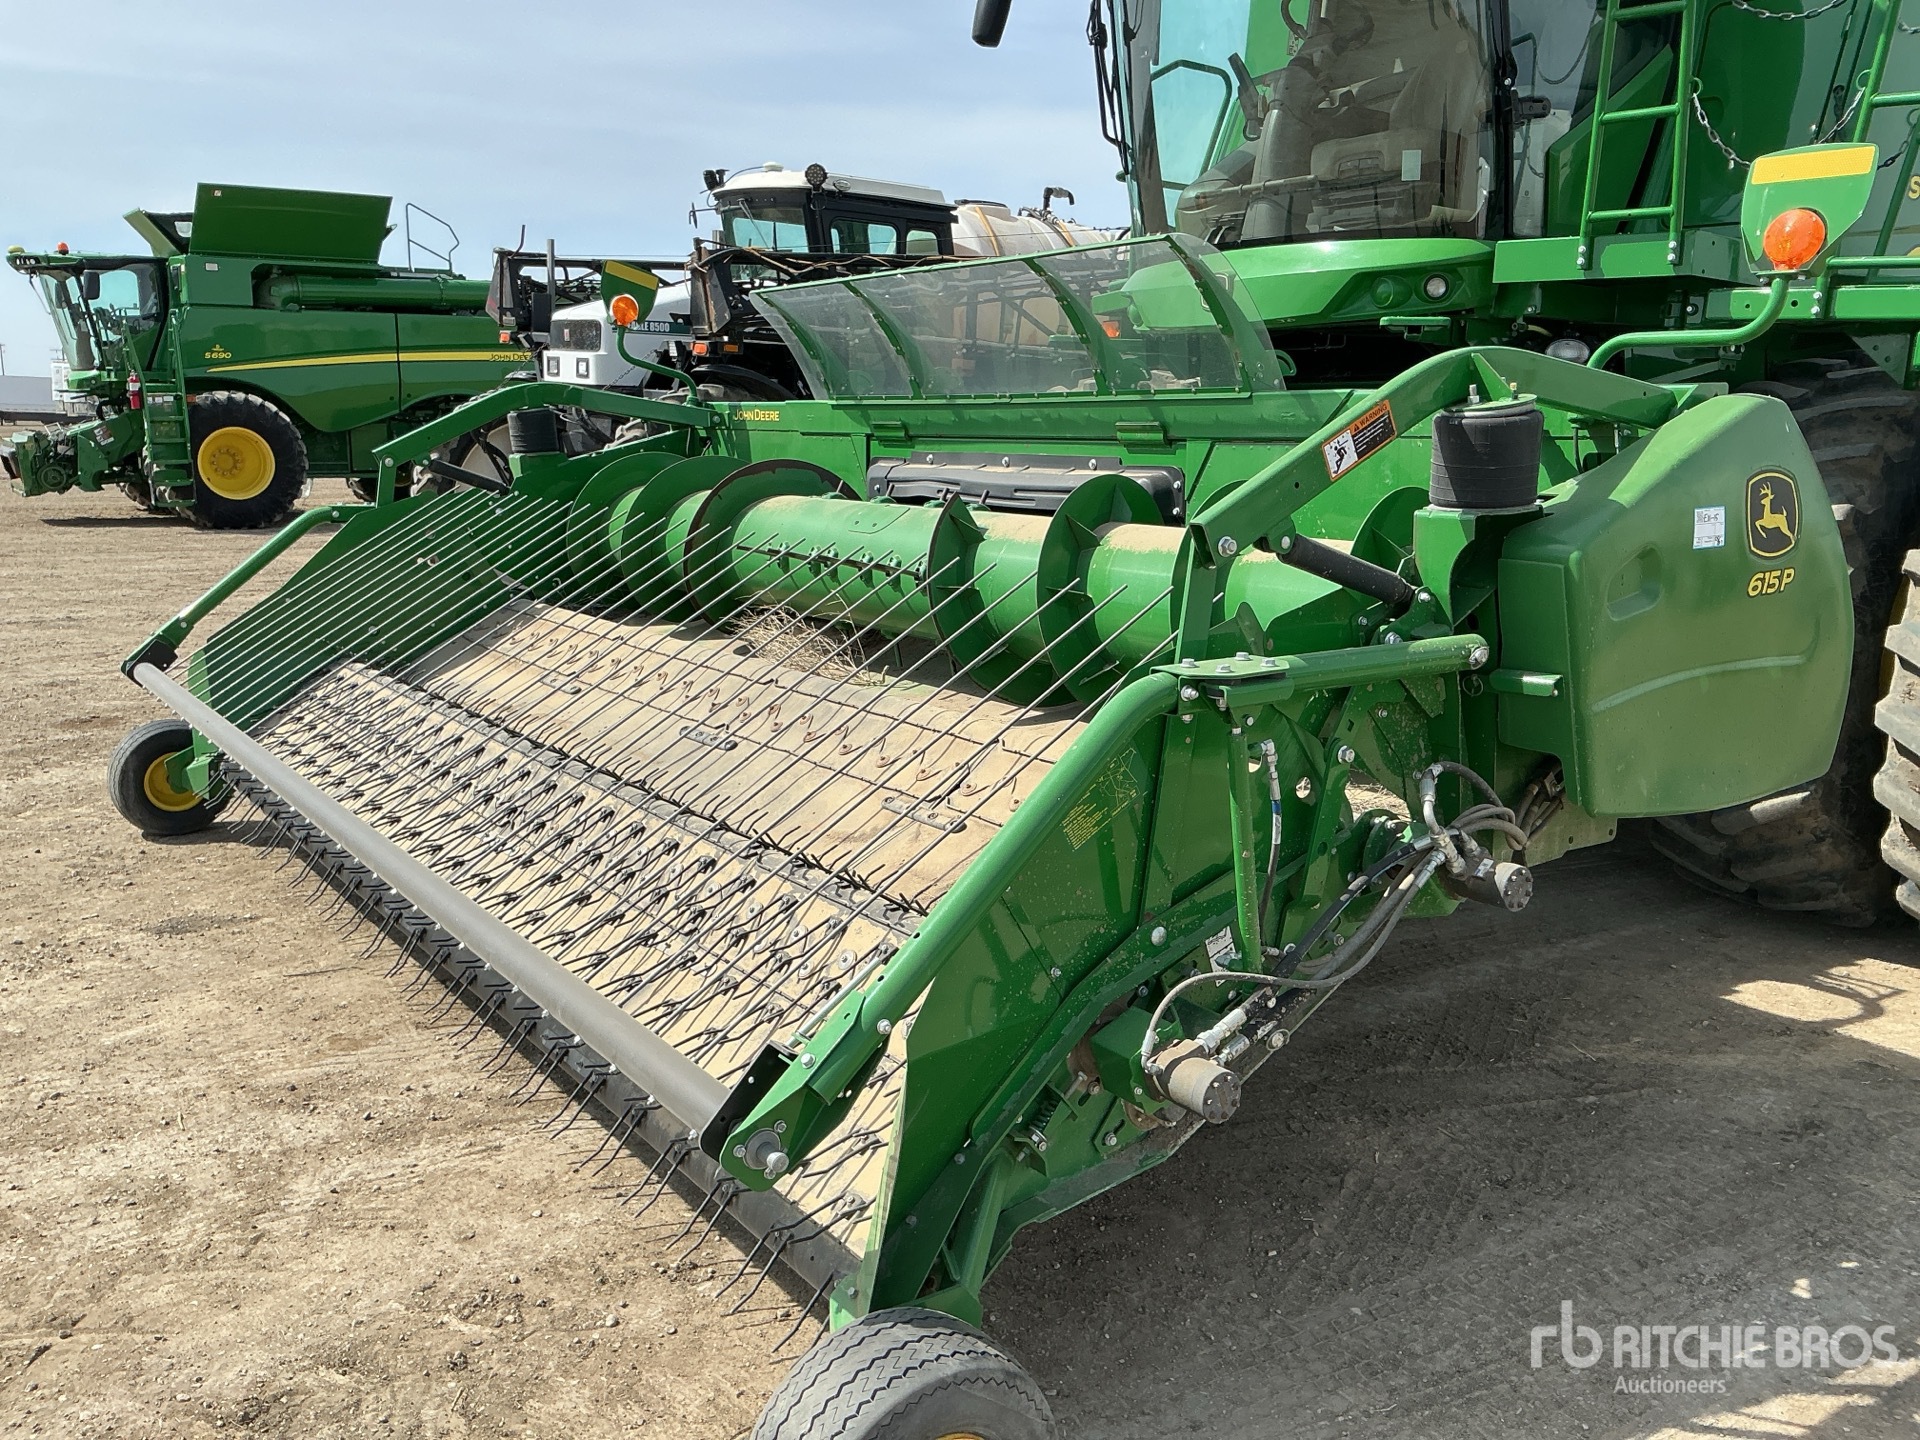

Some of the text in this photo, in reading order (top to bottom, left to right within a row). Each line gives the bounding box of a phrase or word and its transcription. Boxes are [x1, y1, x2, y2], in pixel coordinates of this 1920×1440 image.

[649, 321, 670, 332] 8500
[490, 353, 511, 361] JOHN
[734, 409, 780, 421] JOHN DEERE
[1359, 403, 1388, 428] WARNING
[1747, 567, 1795, 597] 615P
